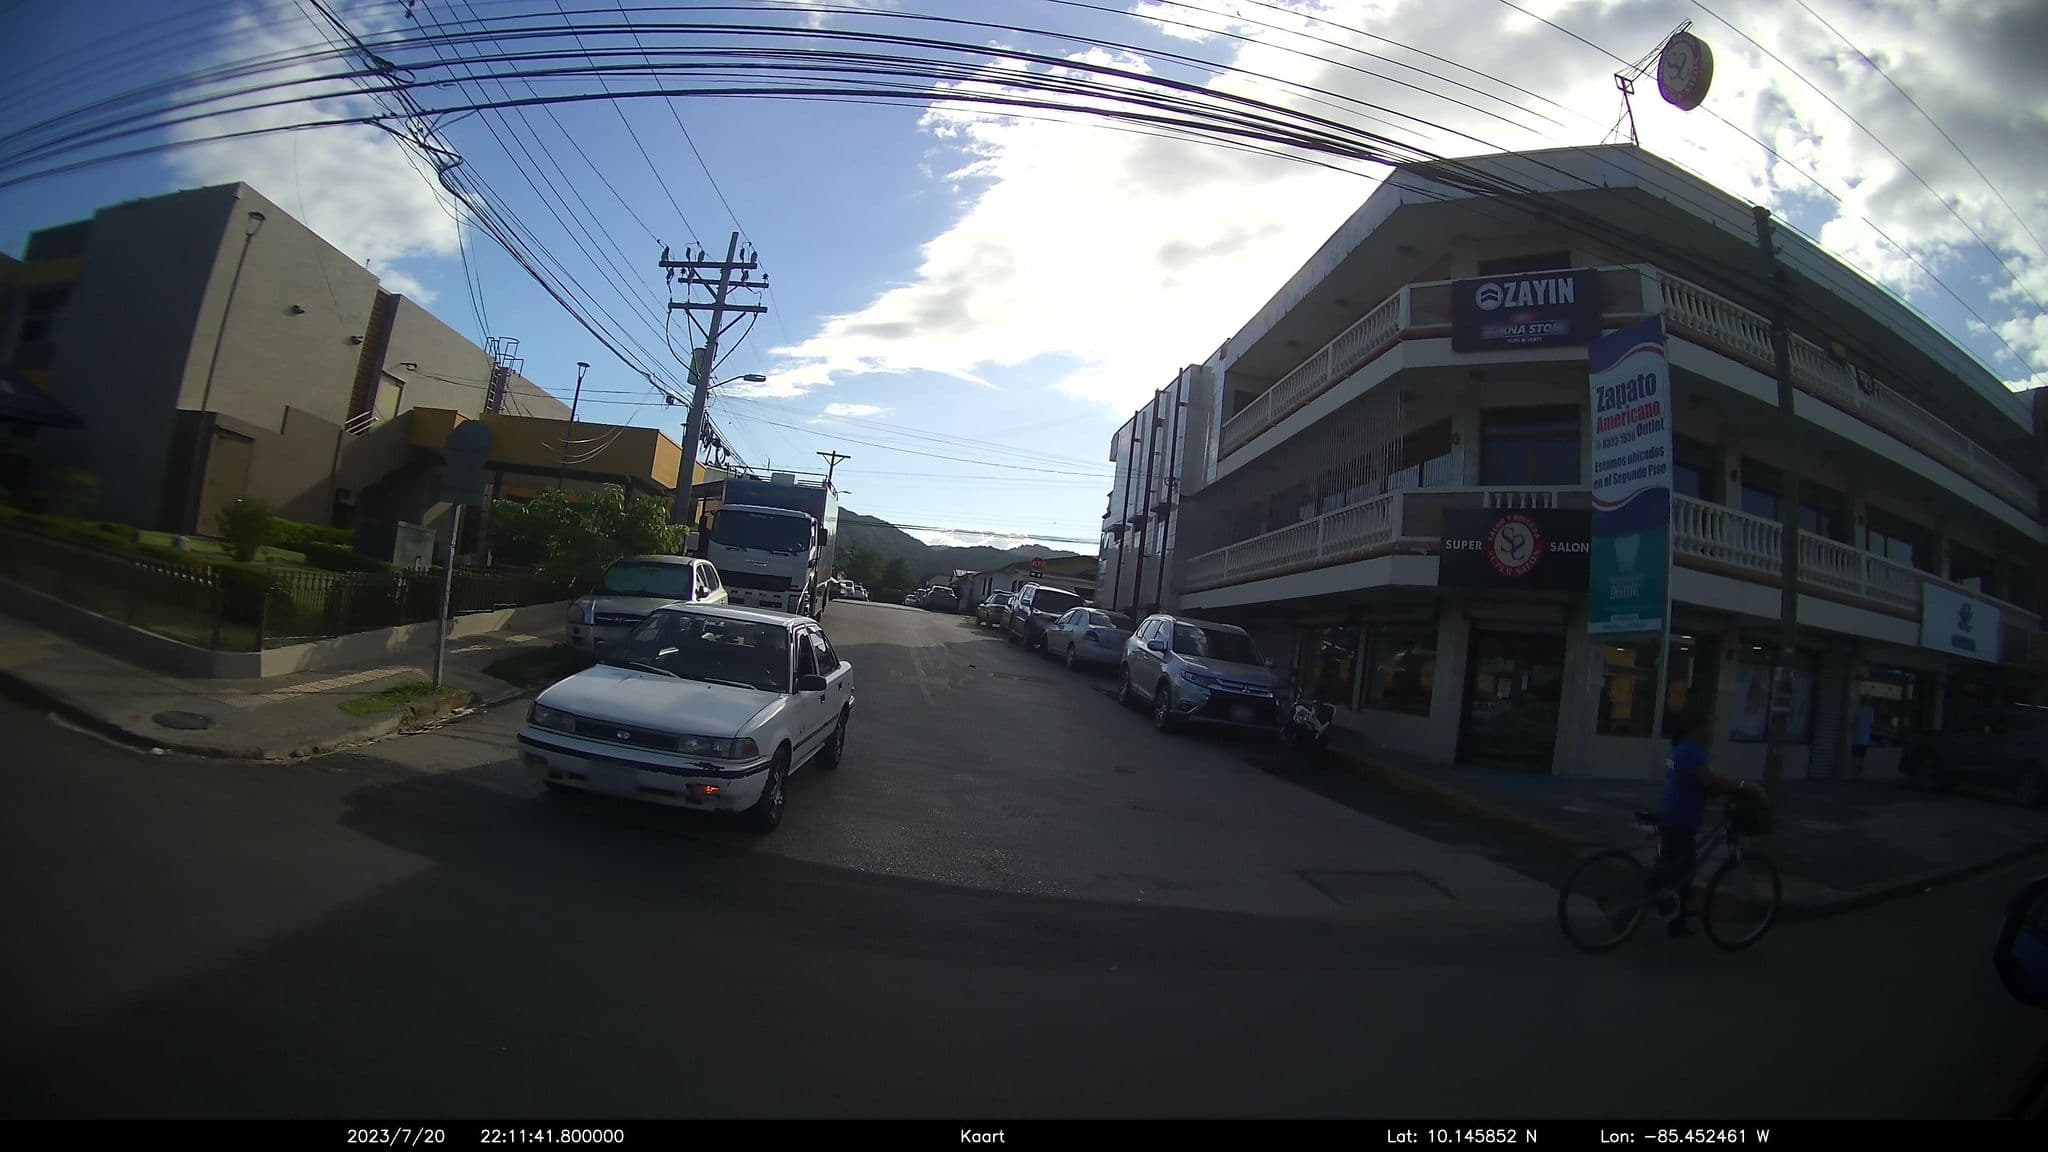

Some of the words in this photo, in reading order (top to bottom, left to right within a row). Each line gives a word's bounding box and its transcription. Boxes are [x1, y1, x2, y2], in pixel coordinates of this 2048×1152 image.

[1504, 277, 1575, 308] ZAYIN
[1596, 373, 1657, 413] Zapato
[1597, 401, 1661, 433] Americano
[1636, 417, 1665, 437] Outlet
[1594, 456, 1627, 473] Estamos
[1627, 446, 1665, 465] ubicados
[1593, 478, 1604, 489] en
[1603, 474, 1612, 487] el
[1612, 466, 1648, 485] Segundo
[1648, 463, 1667, 477] Piso
[1446, 539, 1483, 551] SUPER
[1550, 541, 1591, 553] SALON
